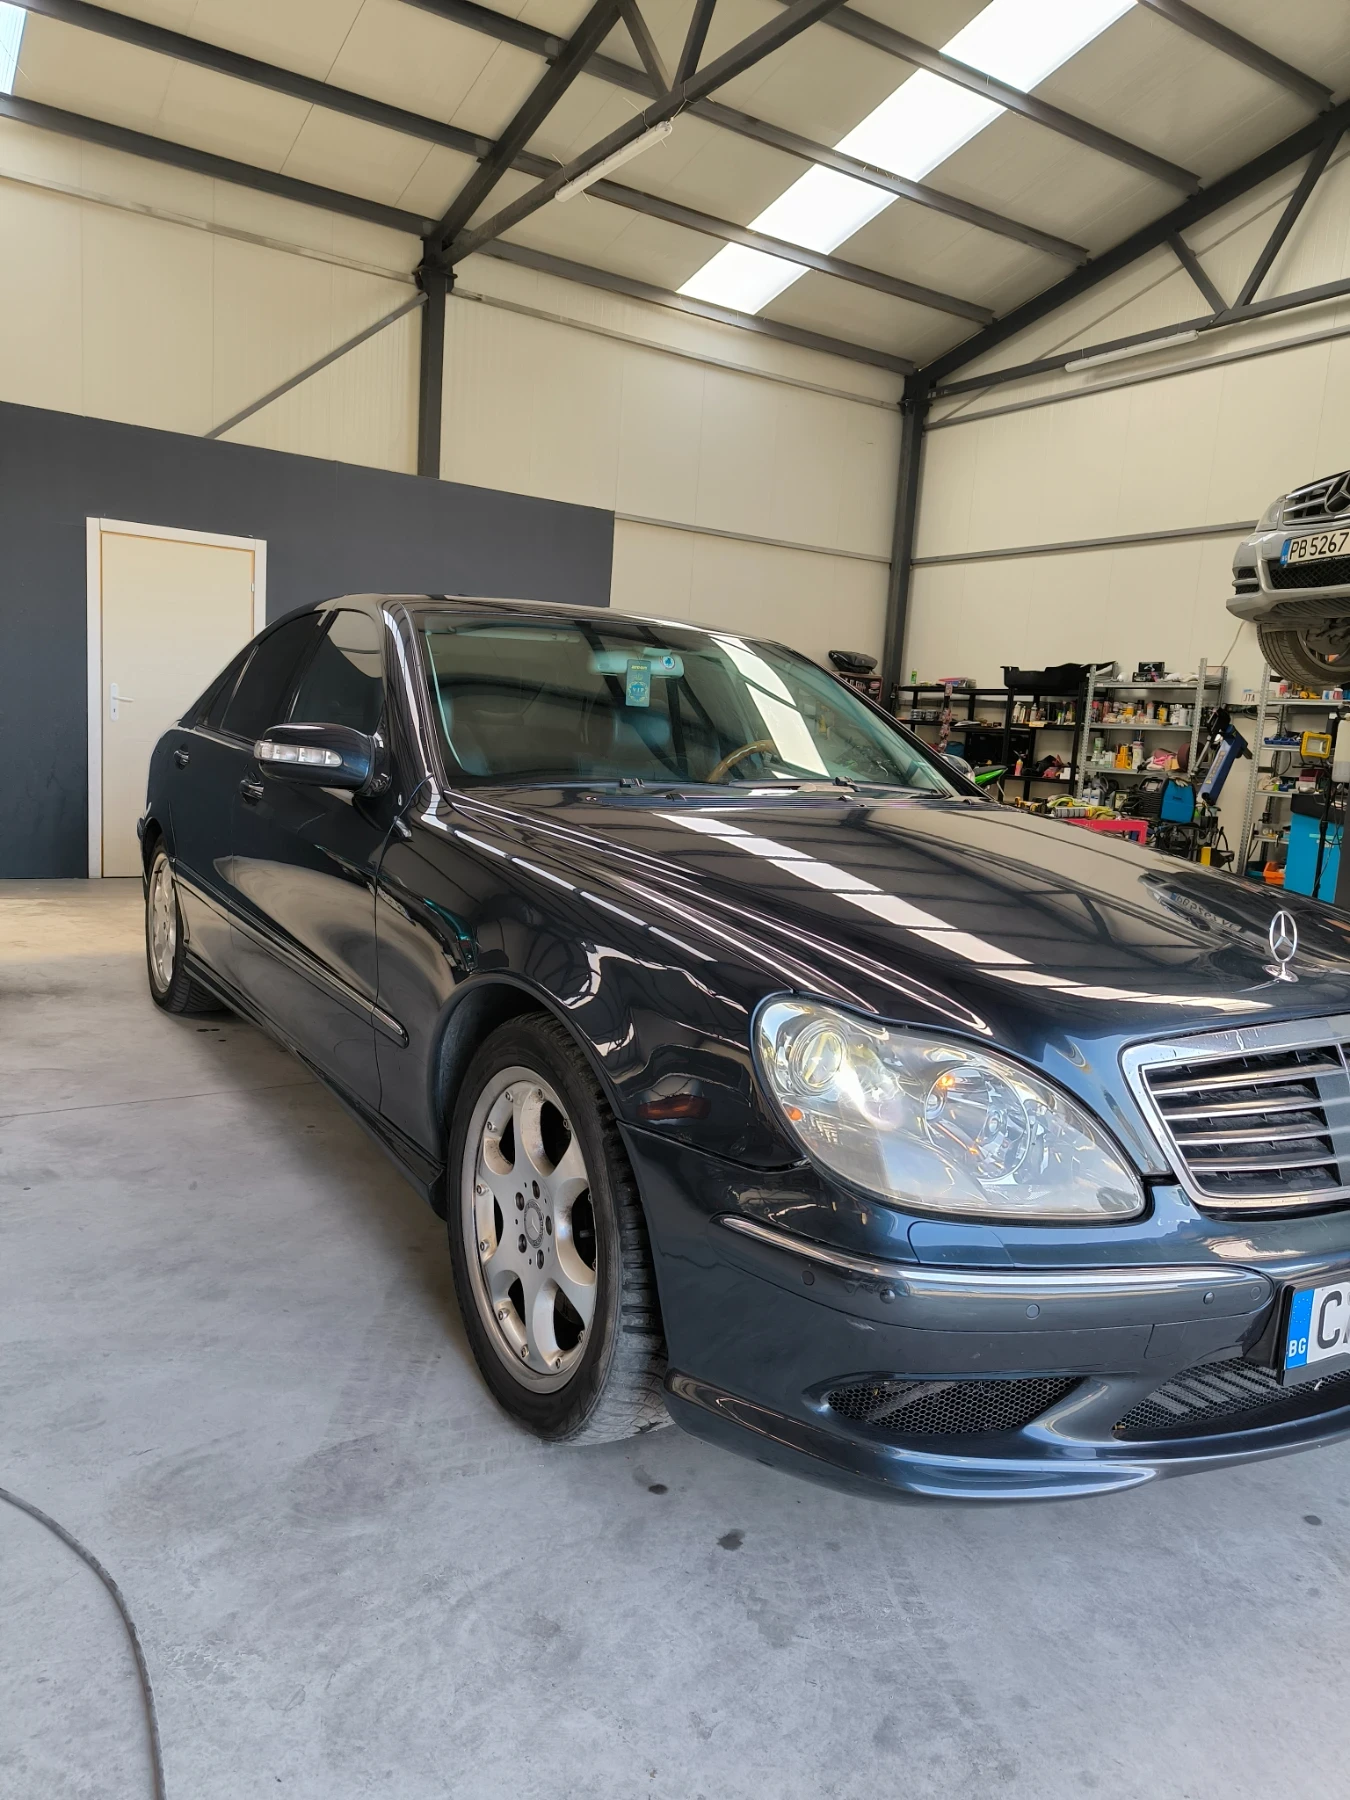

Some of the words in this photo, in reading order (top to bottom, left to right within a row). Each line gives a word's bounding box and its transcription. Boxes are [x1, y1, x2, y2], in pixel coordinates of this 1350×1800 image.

[1289, 539, 1308, 560] PB
[1309, 531, 1350, 557] 5267
[1317, 1290, 1350, 1349] C
[1288, 1337, 1307, 1357] BG
